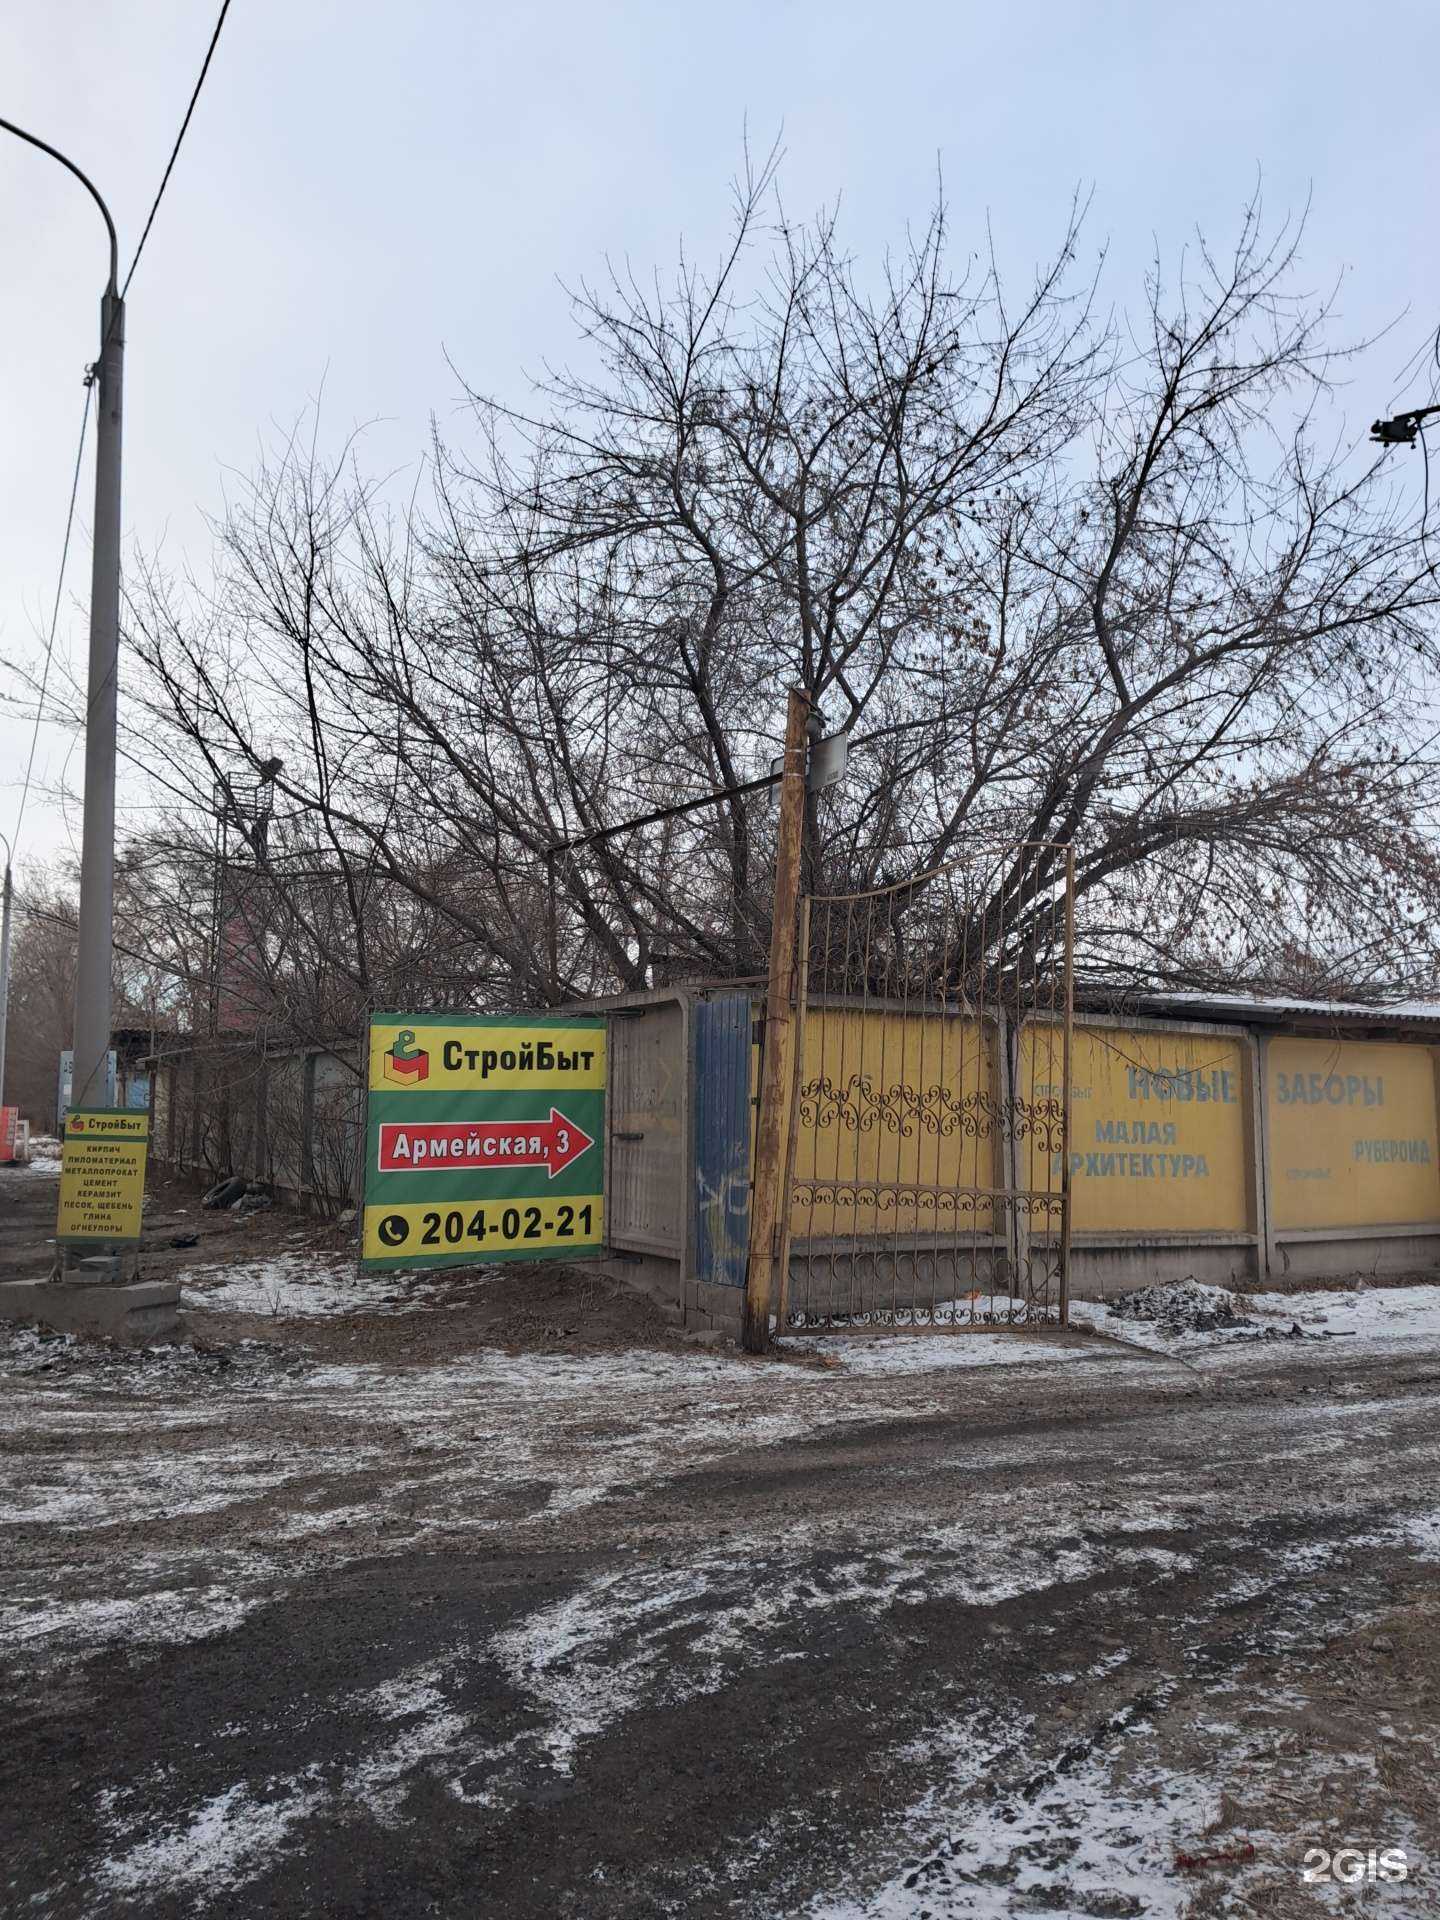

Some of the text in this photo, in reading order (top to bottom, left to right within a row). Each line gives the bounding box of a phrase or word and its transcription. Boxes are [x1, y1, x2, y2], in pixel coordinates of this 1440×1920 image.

[443, 1040, 595, 1079] СтройБыт
[1127, 1067, 1384, 1105] НОВЫЕ ЗАБОРЫ
[88, 1118, 141, 1131] СтройБыт
[1095, 1120, 1177, 1145] МАЛАЯ
[86, 1145, 121, 1153] КИРПИЧ
[392, 1129, 570, 1164] Армейская, 3
[1354, 1139, 1431, 1164] РУБЕРОИД
[68, 1156, 137, 1165] ПИЛОМАТЕРИАЛ
[1052, 1152, 1211, 1178] АРХИТЕКТУРА
[65, 1167, 138, 1176] МЕТАЛЛОПРОКАТ
[83, 1179, 119, 1187] ЦЕМЕНТ
[77, 1190, 122, 1198] КЕРАМЗИТ
[64, 1201, 133, 1210] ПЕСОК, ЩЕБЕНЬ
[83, 1213, 112, 1221] ГЛИНА
[70, 1224, 123, 1232] ОГНЕУПОРЫ
[421, 1204, 592, 1245] 204-02-21
